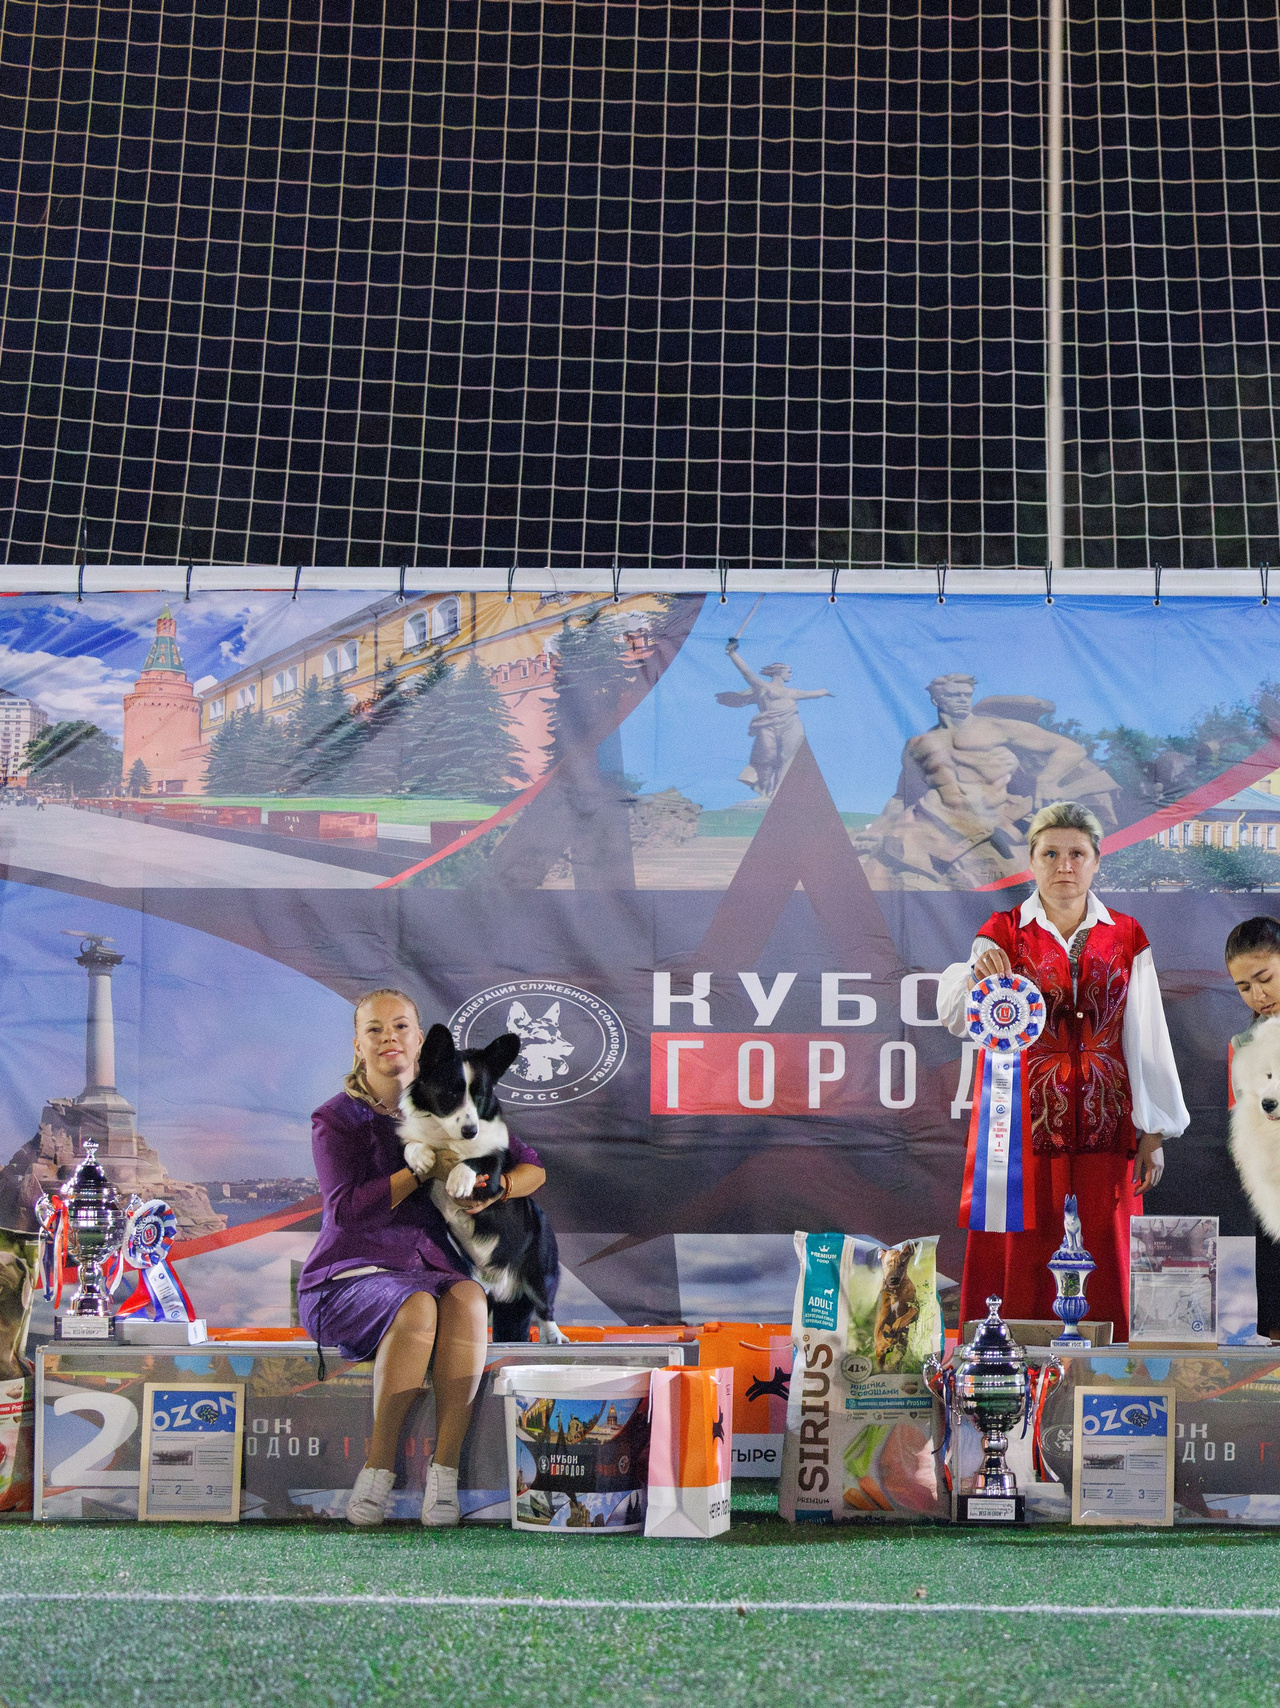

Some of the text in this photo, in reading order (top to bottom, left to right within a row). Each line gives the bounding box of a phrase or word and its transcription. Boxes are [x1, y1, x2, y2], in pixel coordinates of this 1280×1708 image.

[652, 971, 945, 1027] КУБО
[458, 983, 620, 1083] ФЕДЕРАЦИЯ СЛУЖЕБНОГО СОБАКОВОДСТВА
[511, 1091, 560, 1100] РФСС
[807, 1296, 834, 1310] ADULT
[797, 1343, 833, 1493] SIRIUS
[51, 1392, 141, 1487] 2
[730, 1449, 777, 1463] тыре
[175, 1485, 182, 1495] 2
[206, 1485, 213, 1495] 3
[1106, 1488, 1114, 1499] 2
[1138, 1488, 1145, 1500] 3
